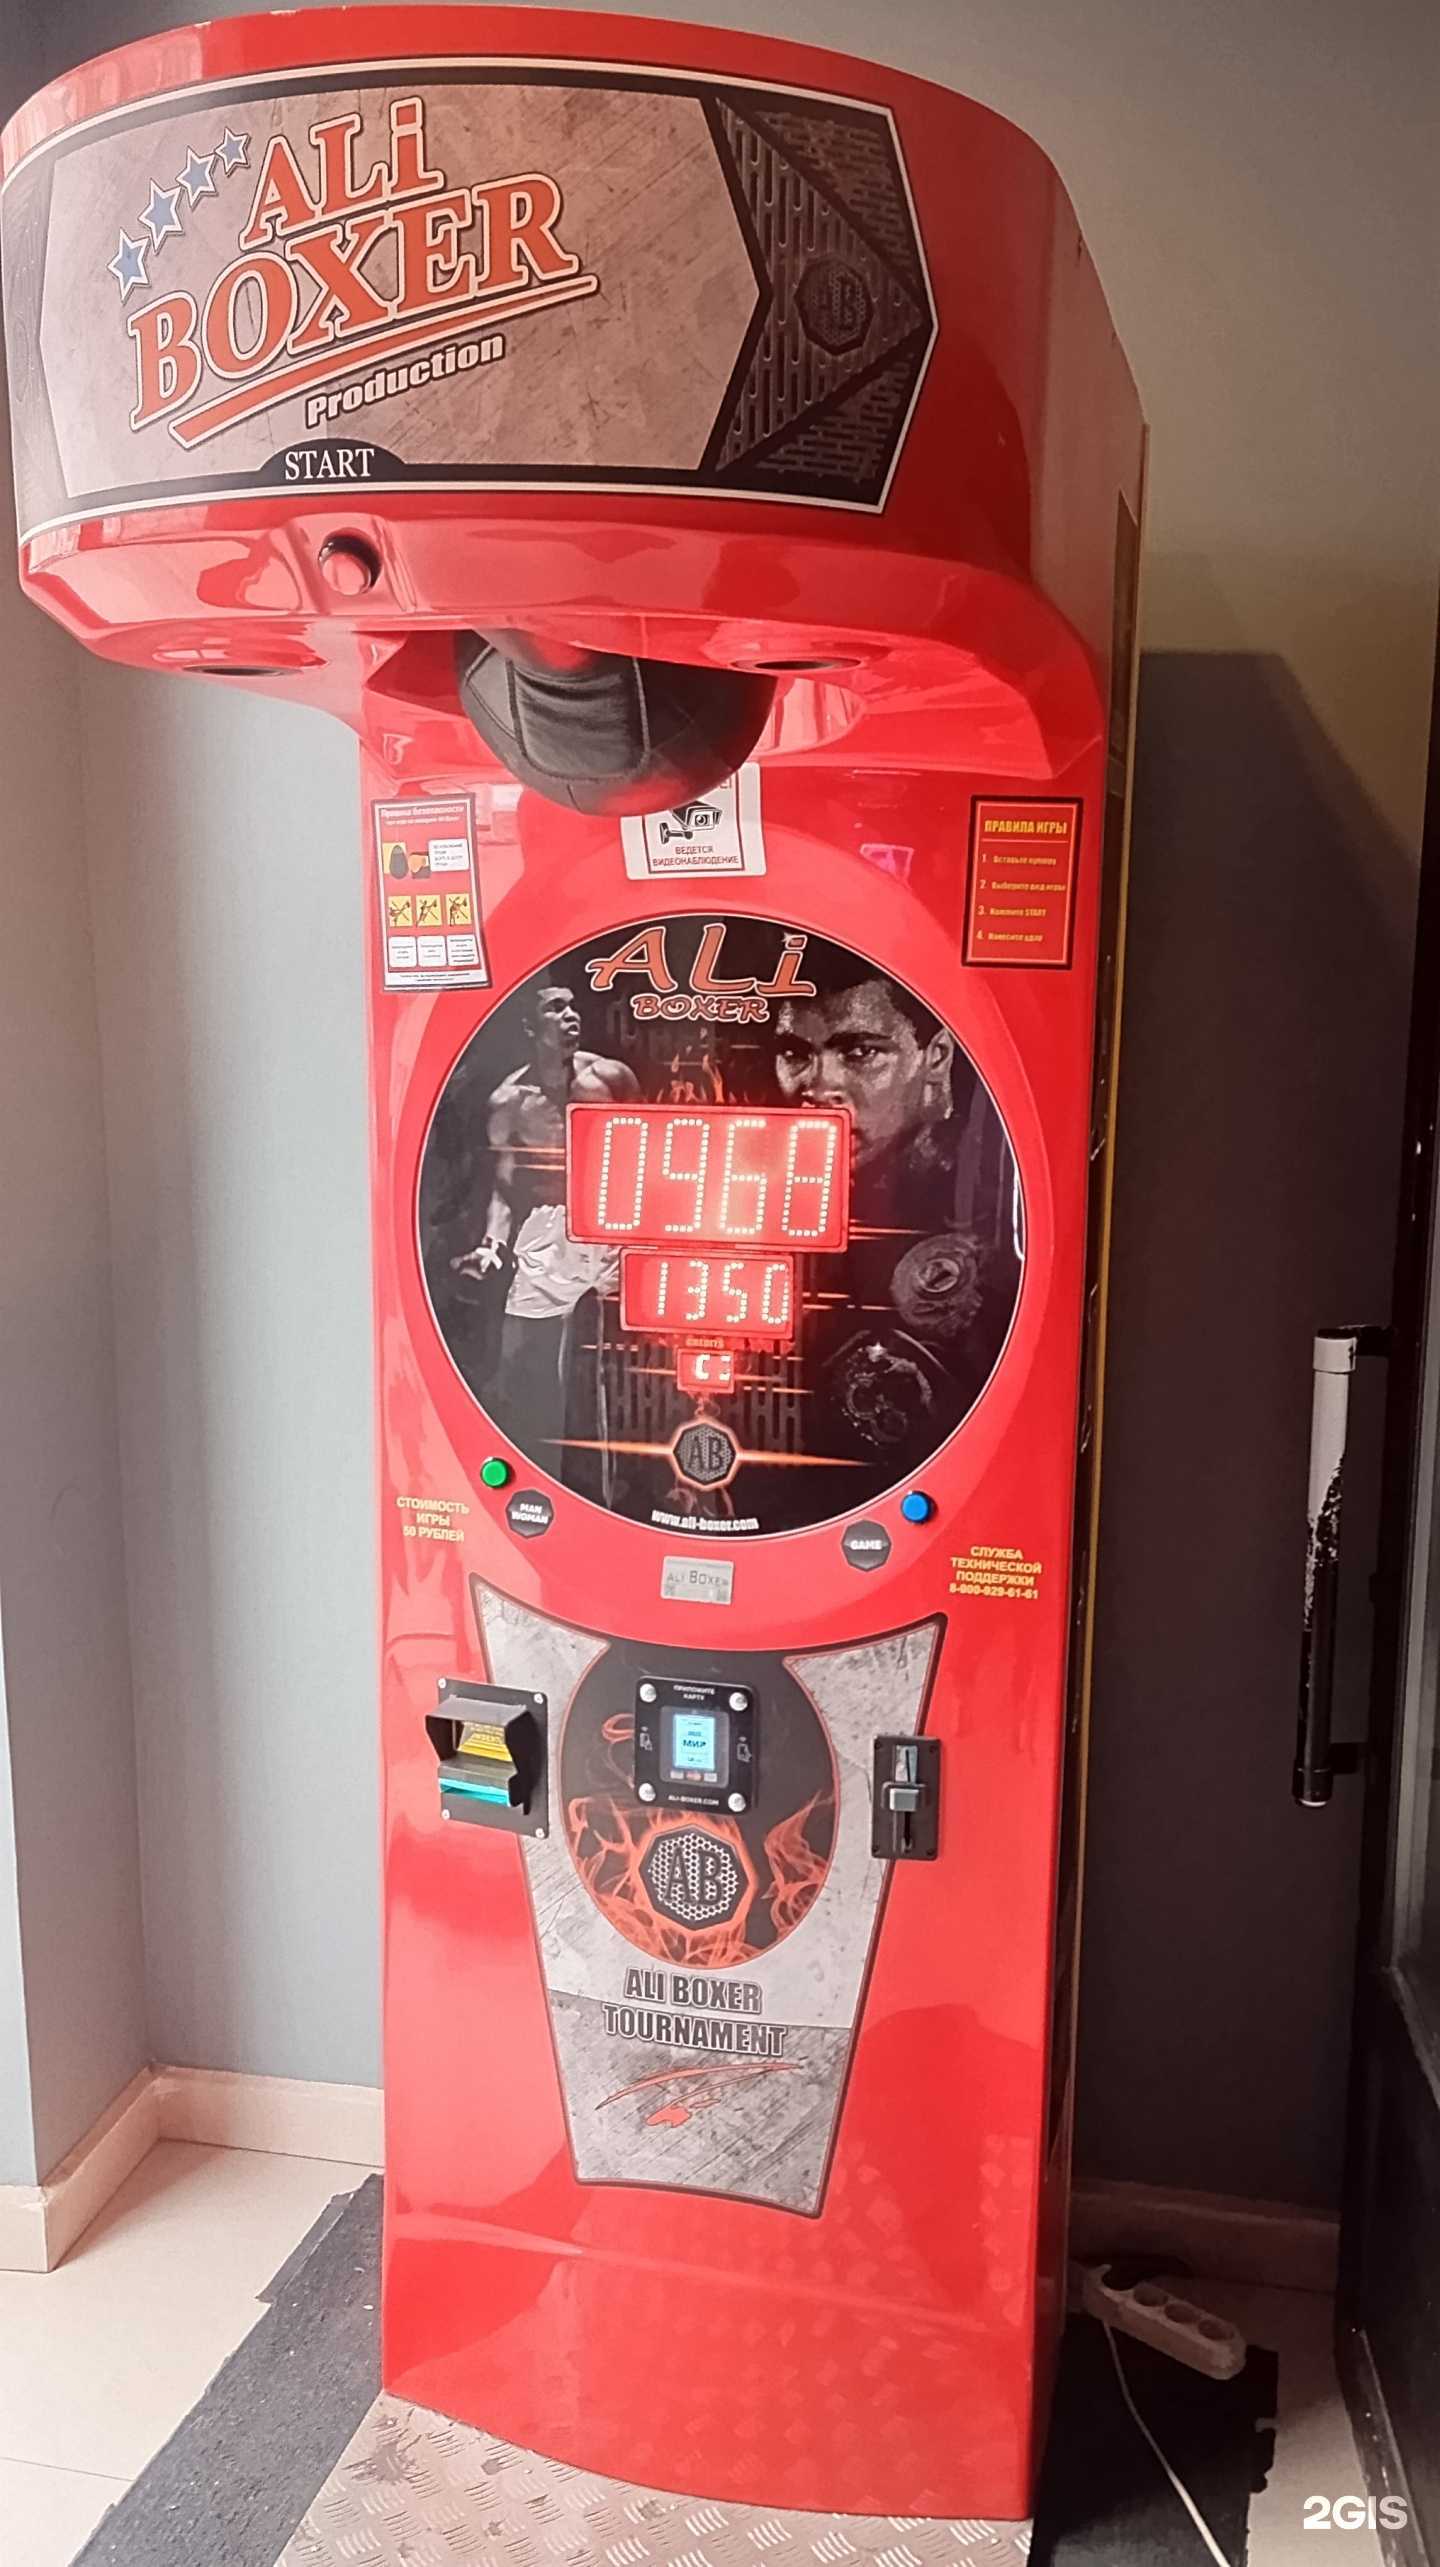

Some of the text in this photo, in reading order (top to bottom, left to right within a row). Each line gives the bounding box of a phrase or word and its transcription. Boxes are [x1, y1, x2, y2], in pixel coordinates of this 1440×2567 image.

[127, 171, 579, 430] BOXER
[305, 333, 504, 428] Production
[284, 447, 375, 481] START
[984, 820, 1067, 834] ПРАВИЛА ИГРЫ
[675, 846, 713, 855] ВЕДЕТСЯ
[652, 856, 739, 867] ВИДЕОНАБЛЮДЕНИЕ
[631, 994, 769, 1023] BOXER
[597, 1116, 837, 1237] 0968
[656, 1260, 790, 1324] 1350
[396, 1496, 470, 1515] СТОИМОСТЬ
[519, 1503, 543, 1514] MAN
[416, 1513, 450, 1527] ИГРЫ
[511, 1511, 549, 1525] WOMAN
[651, 1509, 760, 1532] www.ali-boxer.com
[403, 1525, 465, 1542] 50 РУБЛЕЙ
[850, 1540, 883, 1551] GAME
[970, 1546, 1023, 1560] СЛУЖБА
[951, 1557, 1042, 1574] ТЕХНИЧЕСКОЙ
[956, 1570, 1035, 1586] ПОДДЕРЖКИ
[665, 1848, 724, 1906] AB
[625, 1968, 762, 2014] ALI BOXER
[603, 2005, 787, 2056] TOURNAMENT
